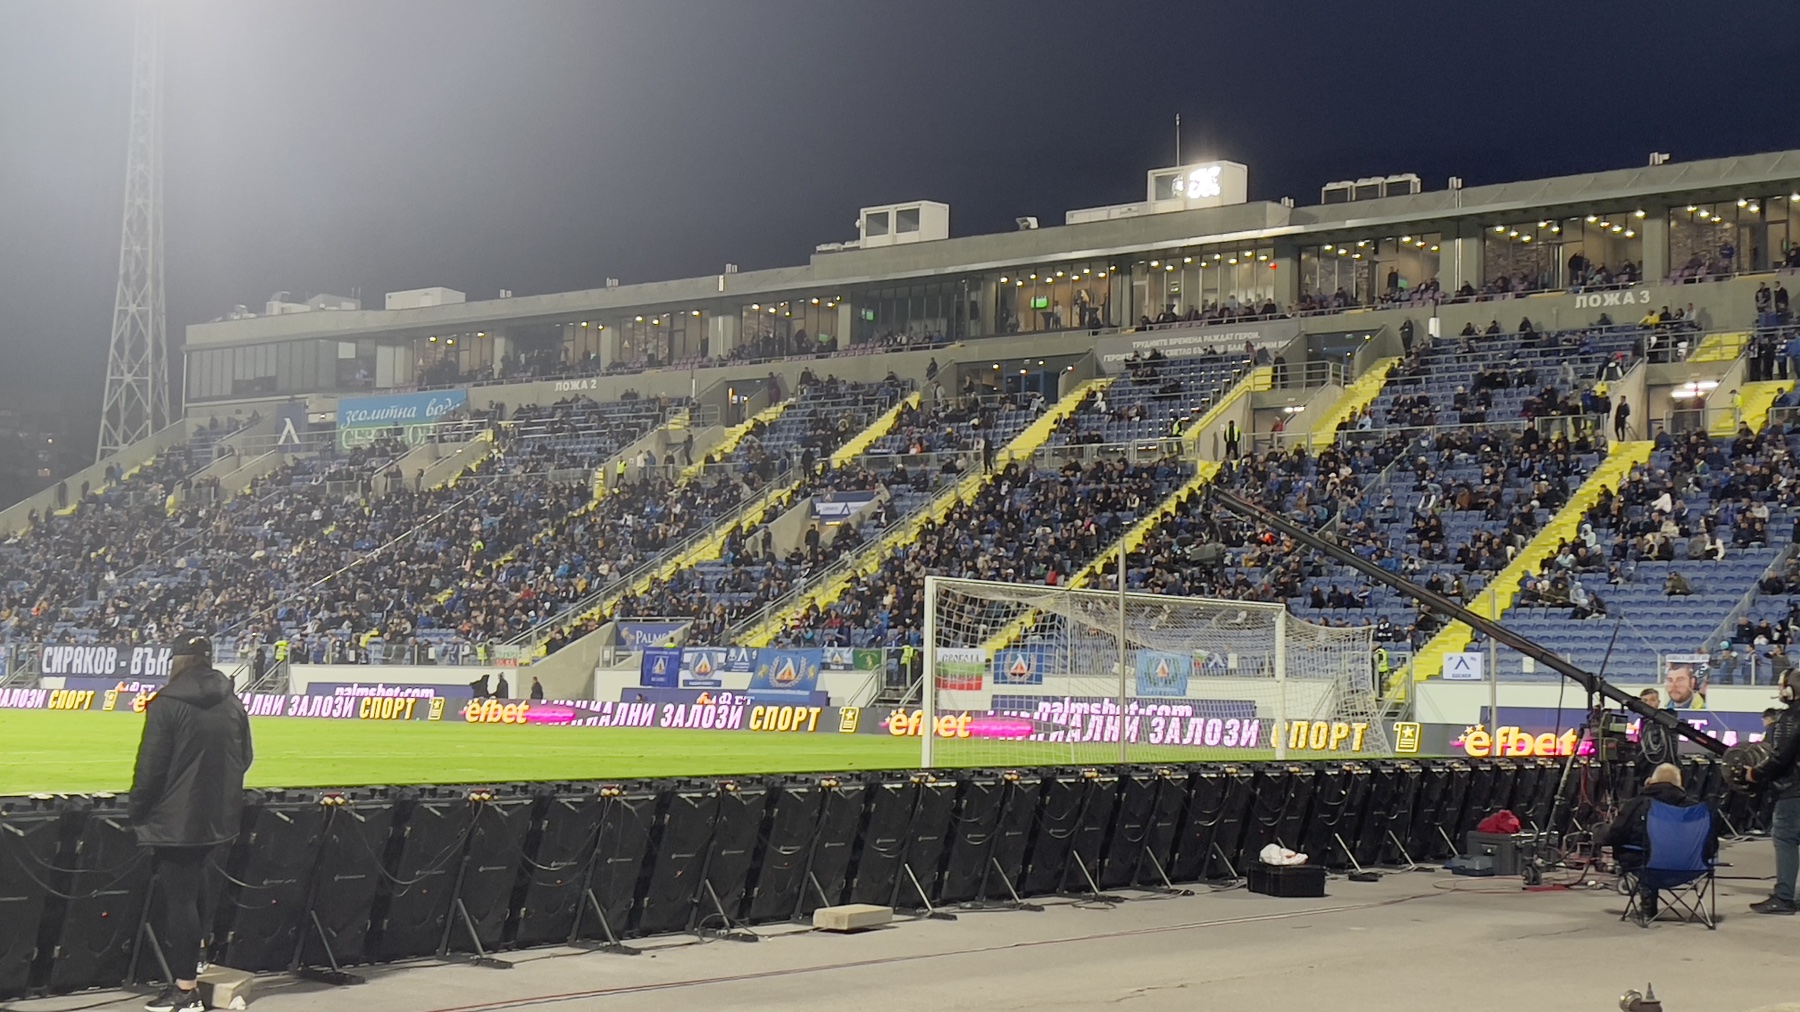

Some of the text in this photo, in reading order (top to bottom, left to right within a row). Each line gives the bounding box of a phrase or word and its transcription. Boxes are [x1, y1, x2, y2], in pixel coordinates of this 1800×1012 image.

[1575, 290, 1651, 309] ЛОЖА 3
[554, 379, 597, 392] ЛОЖА 2
[42, 646, 118, 675] СИРАКОВ
[48, 690, 95, 711] СПОРТ
[288, 695, 356, 718] ЗАЛОЗИ
[359, 697, 417, 721] СПОРТ
[465, 697, 530, 724] efbet
[660, 704, 744, 730] ЗАЛОЗИ
[749, 705, 822, 732] СПОРТ
[1149, 717, 1260, 748] ЗАЛОЗИ
[1464, 725, 1578, 758] efbet
